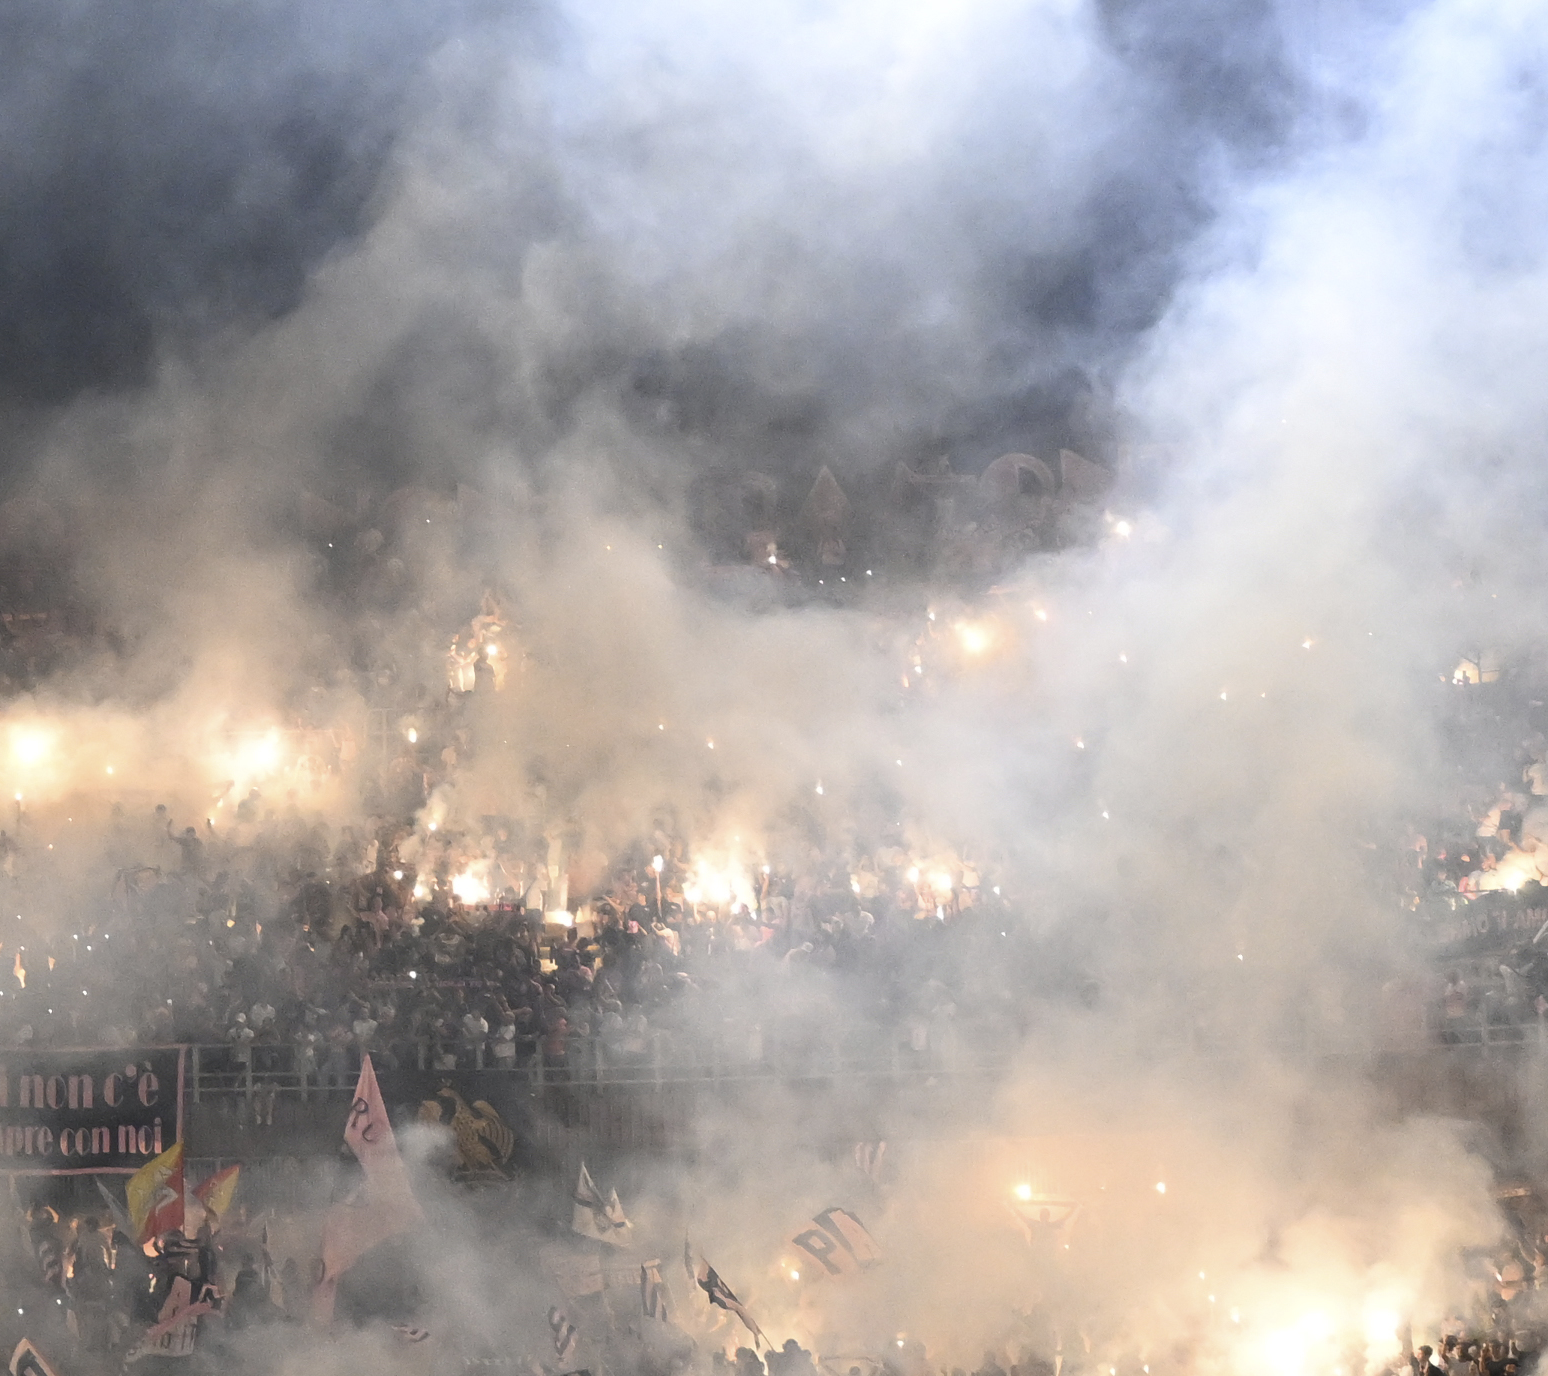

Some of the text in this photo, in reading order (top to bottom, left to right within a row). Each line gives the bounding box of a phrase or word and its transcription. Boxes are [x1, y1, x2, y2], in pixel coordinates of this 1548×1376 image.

[19, 1072, 95, 1110] non
[103, 1060, 160, 1109] c'è
[59, 1125, 111, 1157] con
[118, 1116, 164, 1156] noi
